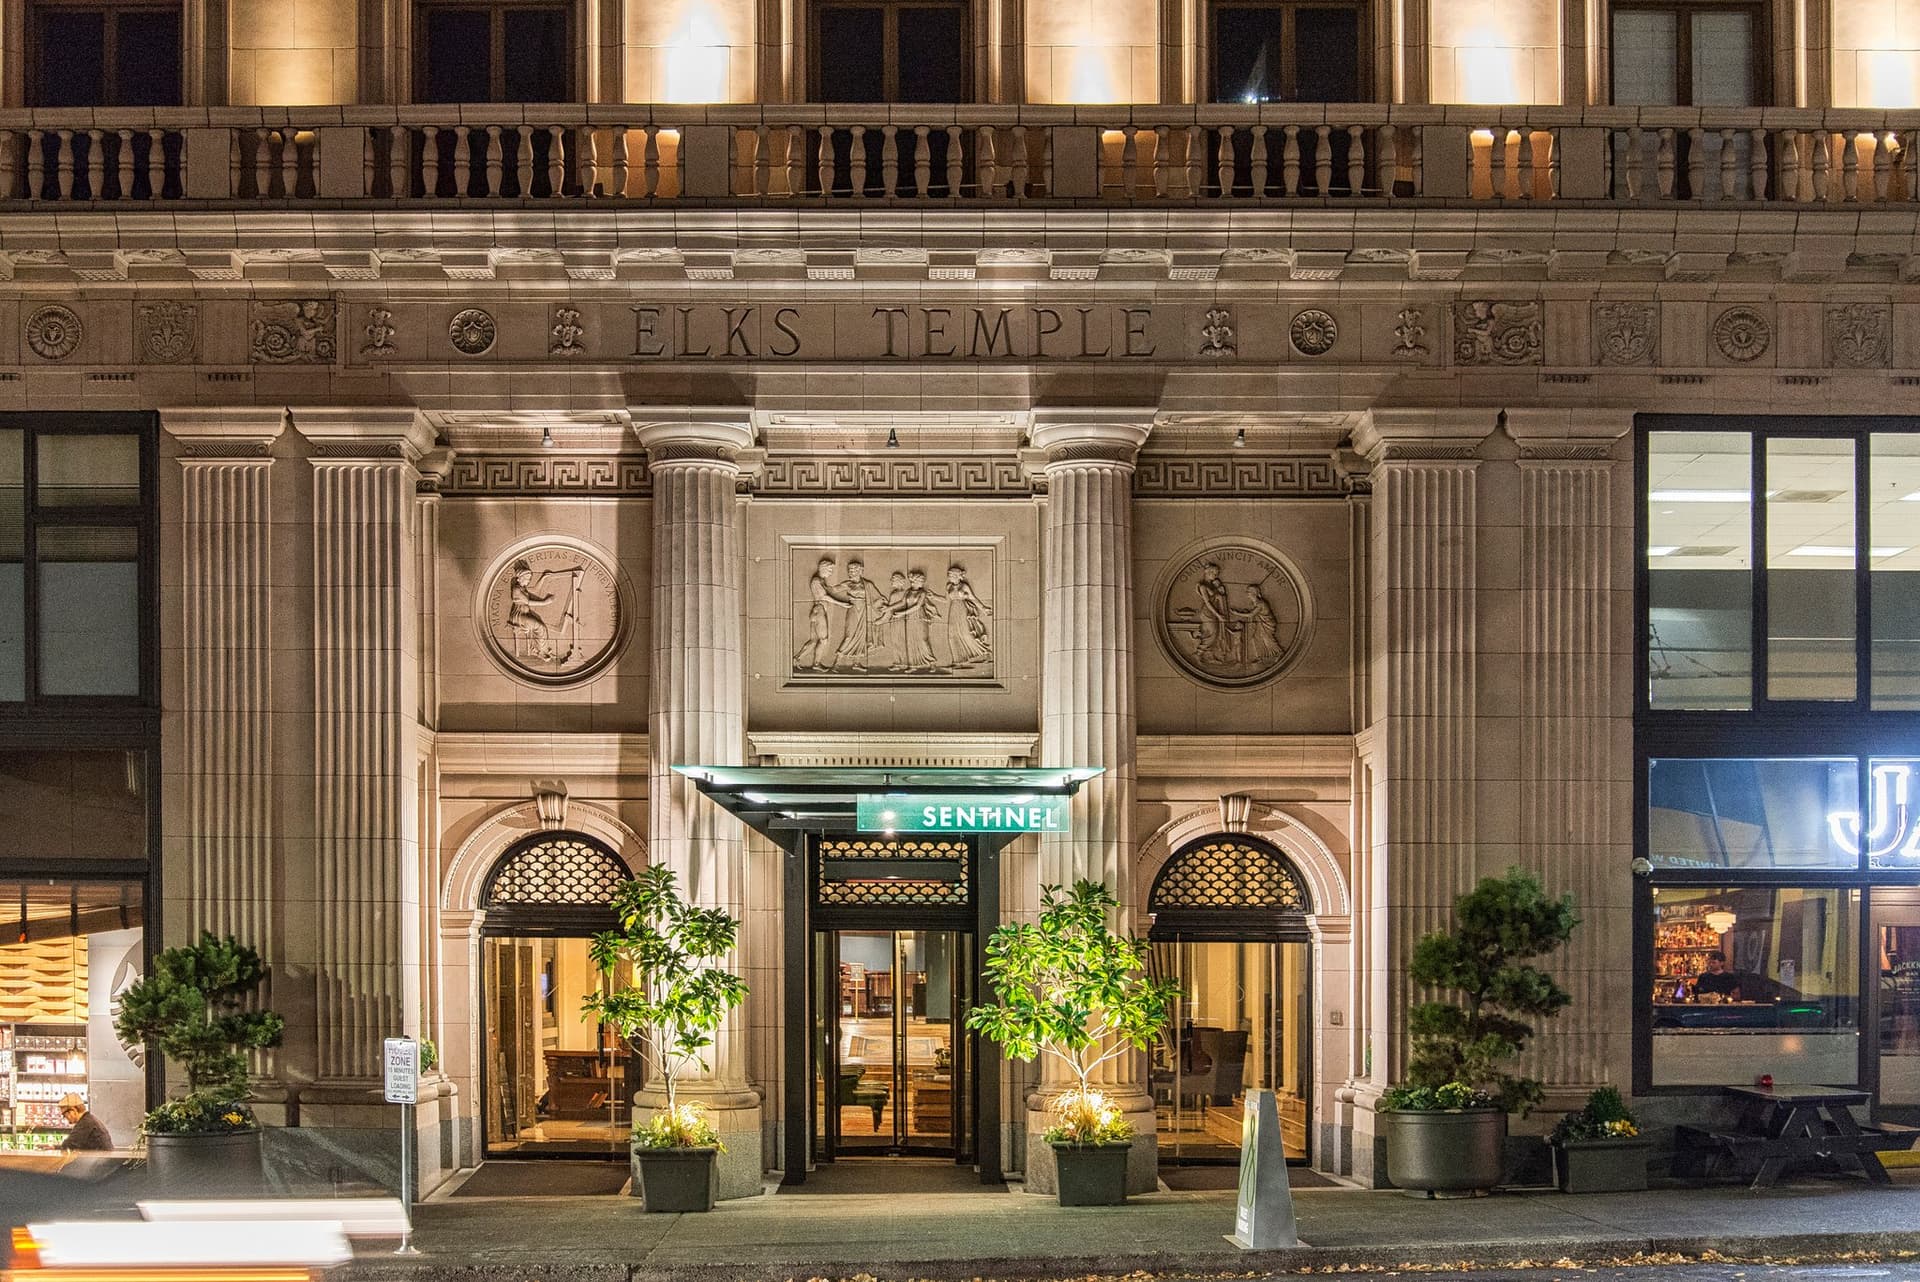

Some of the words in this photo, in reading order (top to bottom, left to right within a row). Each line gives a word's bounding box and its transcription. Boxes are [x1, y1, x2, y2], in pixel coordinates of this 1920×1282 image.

[628, 306, 801, 358] ELKS
[871, 306, 1157, 358] TEMPLE
[1179, 556, 1209, 583] OMN
[1214, 551, 1255, 563] VINCIT
[1256, 561, 1286, 586] AMOR
[490, 587, 505, 628] MAGNA
[572, 556, 588, 567] ET
[922, 806, 1057, 828] SENTINEL
[390, 1056, 411, 1066] ZONE
[390, 1082, 412, 1090] LOADING
